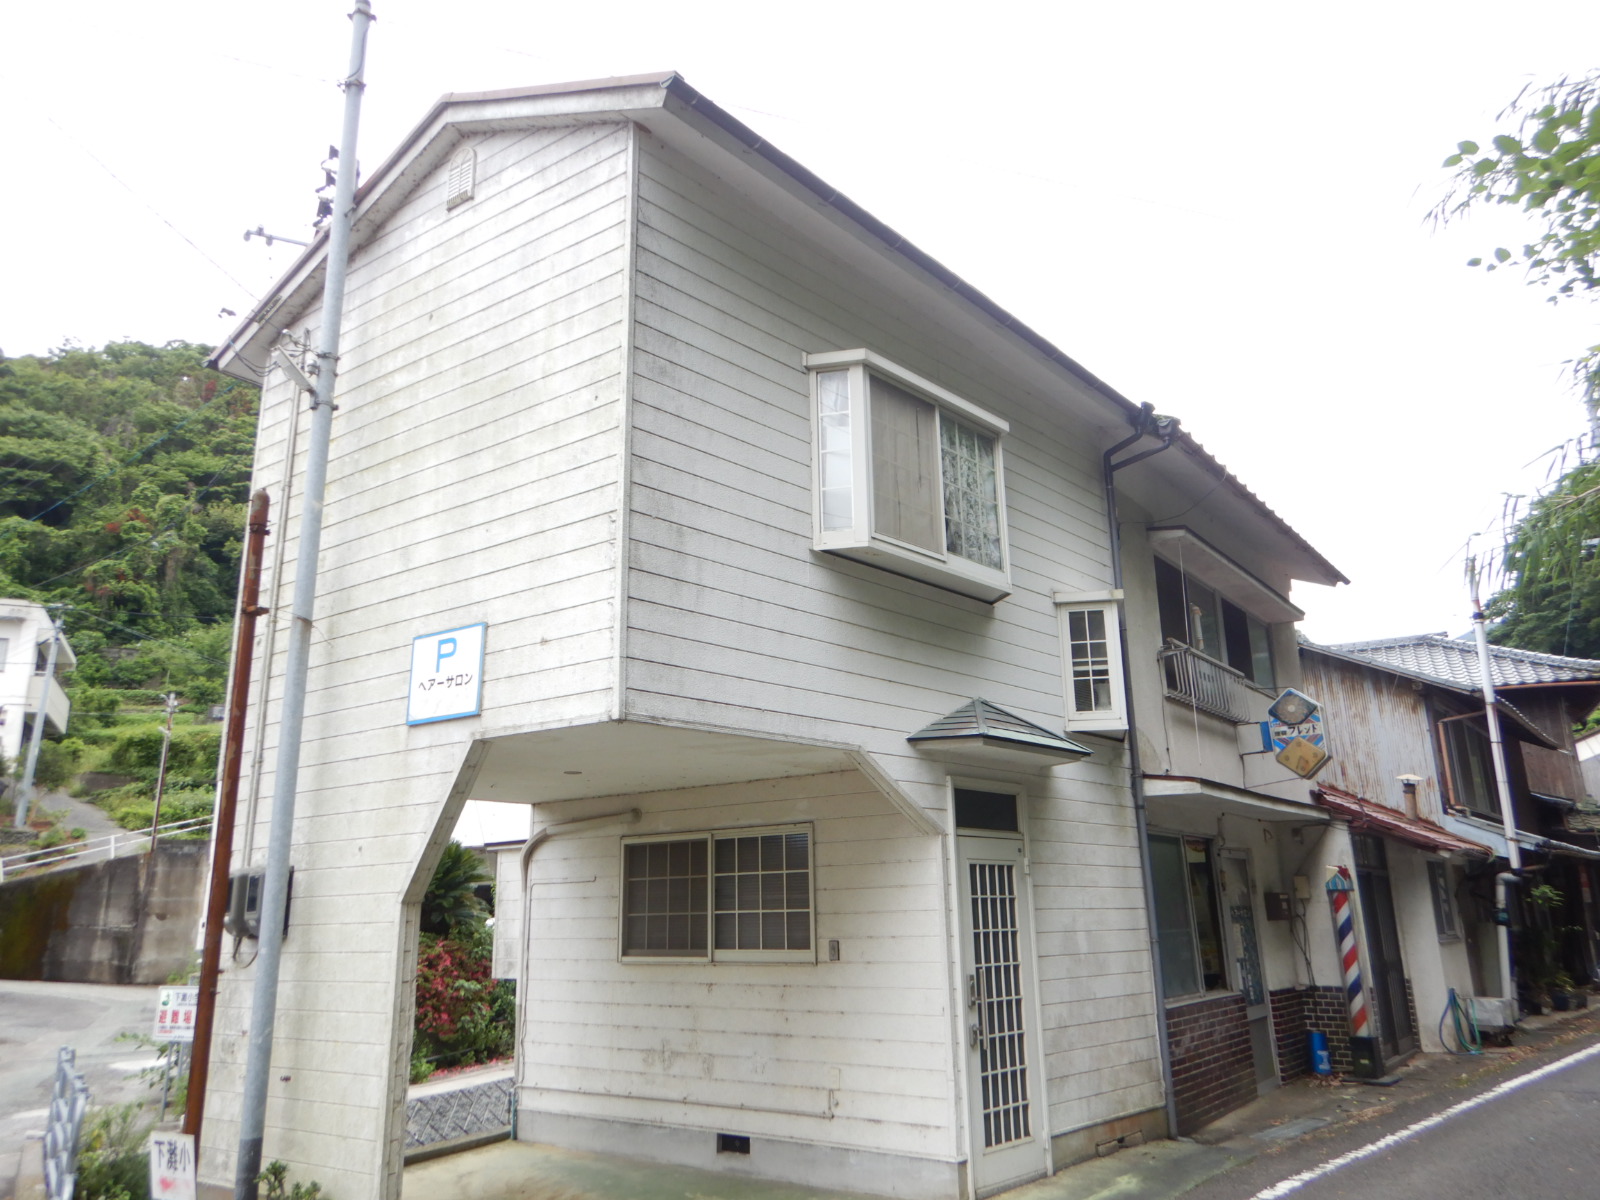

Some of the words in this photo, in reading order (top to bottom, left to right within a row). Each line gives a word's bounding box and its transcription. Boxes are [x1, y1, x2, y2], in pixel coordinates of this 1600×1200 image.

[436, 637, 457, 673] P
[418, 673, 473, 691] ヘアーサロン
